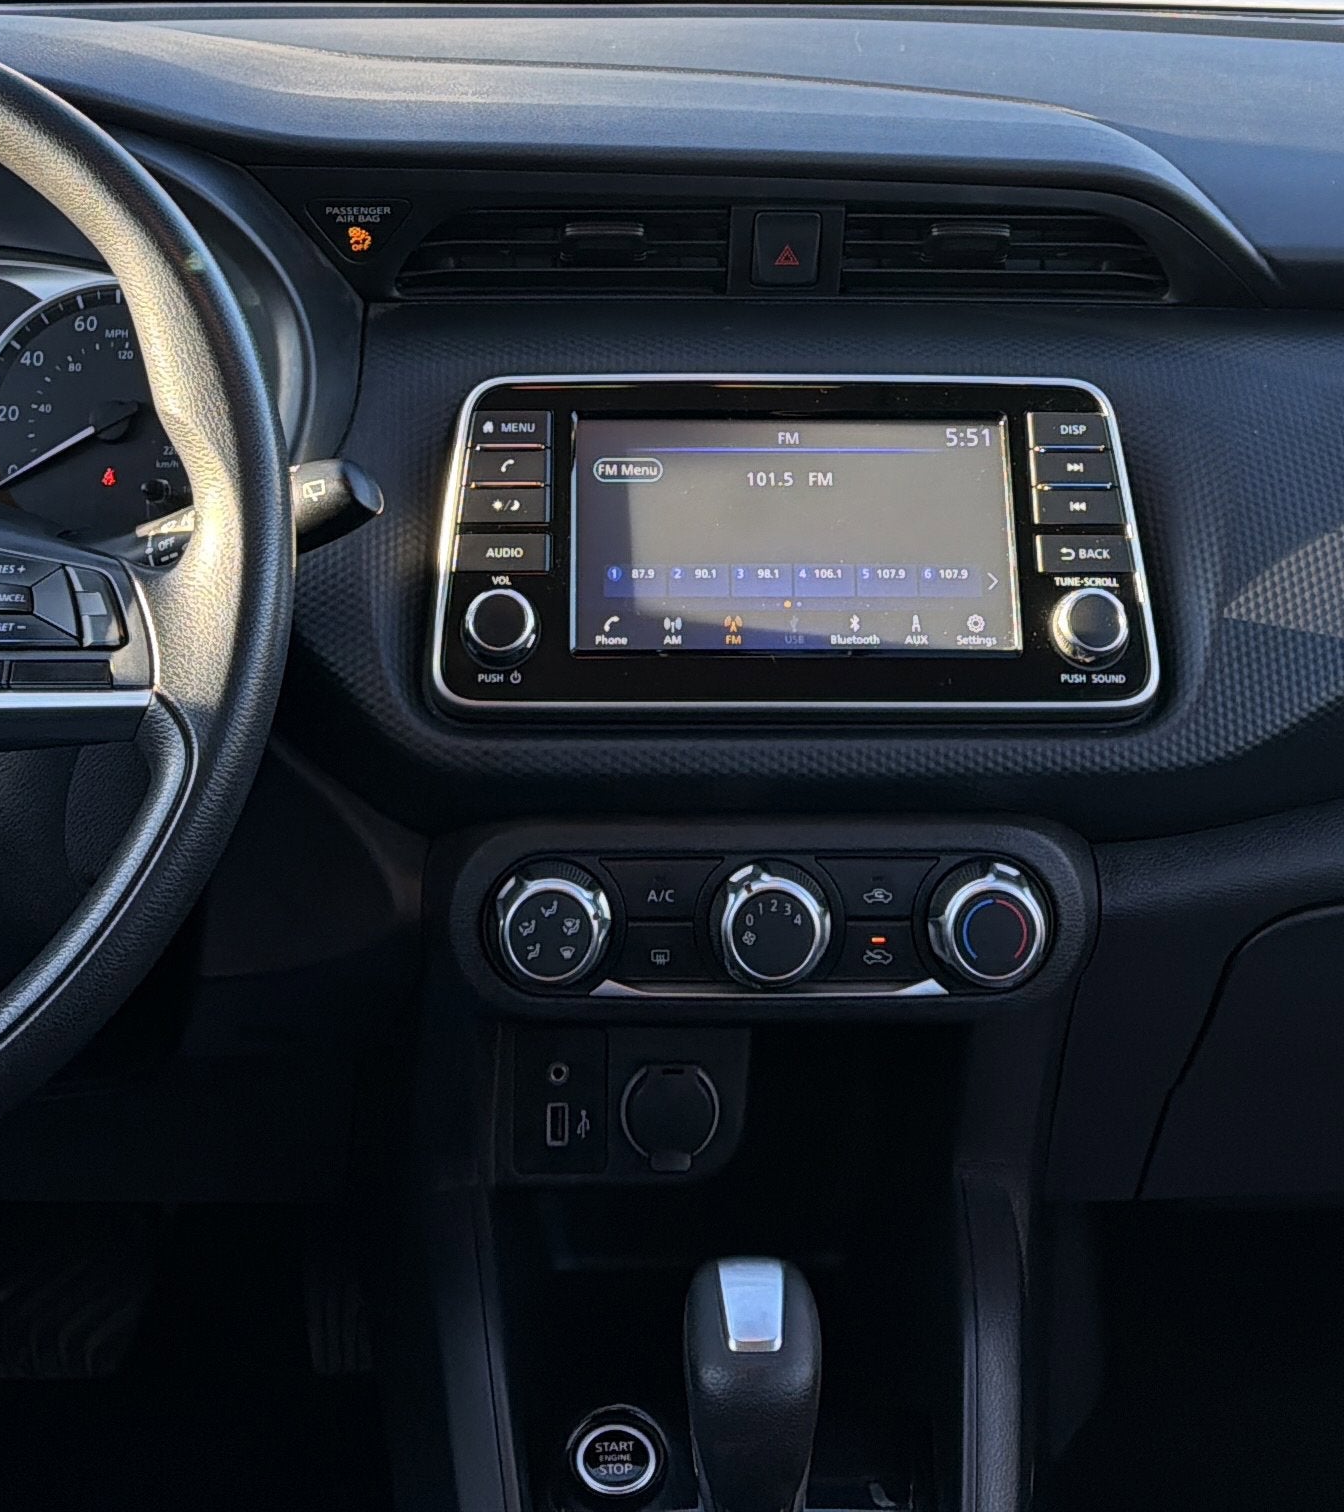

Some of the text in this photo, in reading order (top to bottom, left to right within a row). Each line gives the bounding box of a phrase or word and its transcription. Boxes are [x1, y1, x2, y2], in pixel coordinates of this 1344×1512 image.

[325, 206, 392, 215] PASSENGER
[335, 214, 381, 223] AIR BAG
[74, 315, 98, 332] 60
[104, 329, 129, 339] MPH
[20, 351, 44, 366] 40
[117, 350, 134, 360] 120
[67, 363, 82, 372] 80
[38, 403, 52, 414] 40
[500, 422, 536, 433] MENU
[1060, 424, 1087, 435] DISP
[777, 428, 993, 448] FM 5:51
[598, 464, 658, 477] FM Menu
[746, 473, 833, 487] 101.5 FM
[158, 537, 176, 552] OFF
[485, 547, 524, 559] AUDIO
[1079, 549, 1111, 559] BACK
[631, 569, 655, 579] 87.9
[694, 569, 717, 579] 90.1
[757, 569, 779, 579] 98.1
[814, 569, 842, 579] 106.1
[876, 569, 906, 579] 107.9
[939, 569, 968, 579] 107.9
[491, 575, 512, 585] VOL
[595, 635, 628, 646] Phone
[663, 635, 682, 646] AM
[725, 635, 741, 646] FM
[831, 635, 880, 646] Bluetooth
[904, 635, 929, 646] AUX
[956, 635, 997, 647] Settings
[478, 672, 504, 683] PUSH
[1060, 674, 1127, 684] PUSH SOUND
[647, 889, 675, 904] A/C
[757, 902, 764, 915] 1
[770, 900, 778, 913] 2
[783, 902, 792, 916] 3
[745, 913, 754, 926] 0
[793, 913, 802, 926] 4
[594, 1440, 635, 1454] START
[599, 1454, 632, 1462] ENGINE
[598, 1462, 633, 1476] STOP
